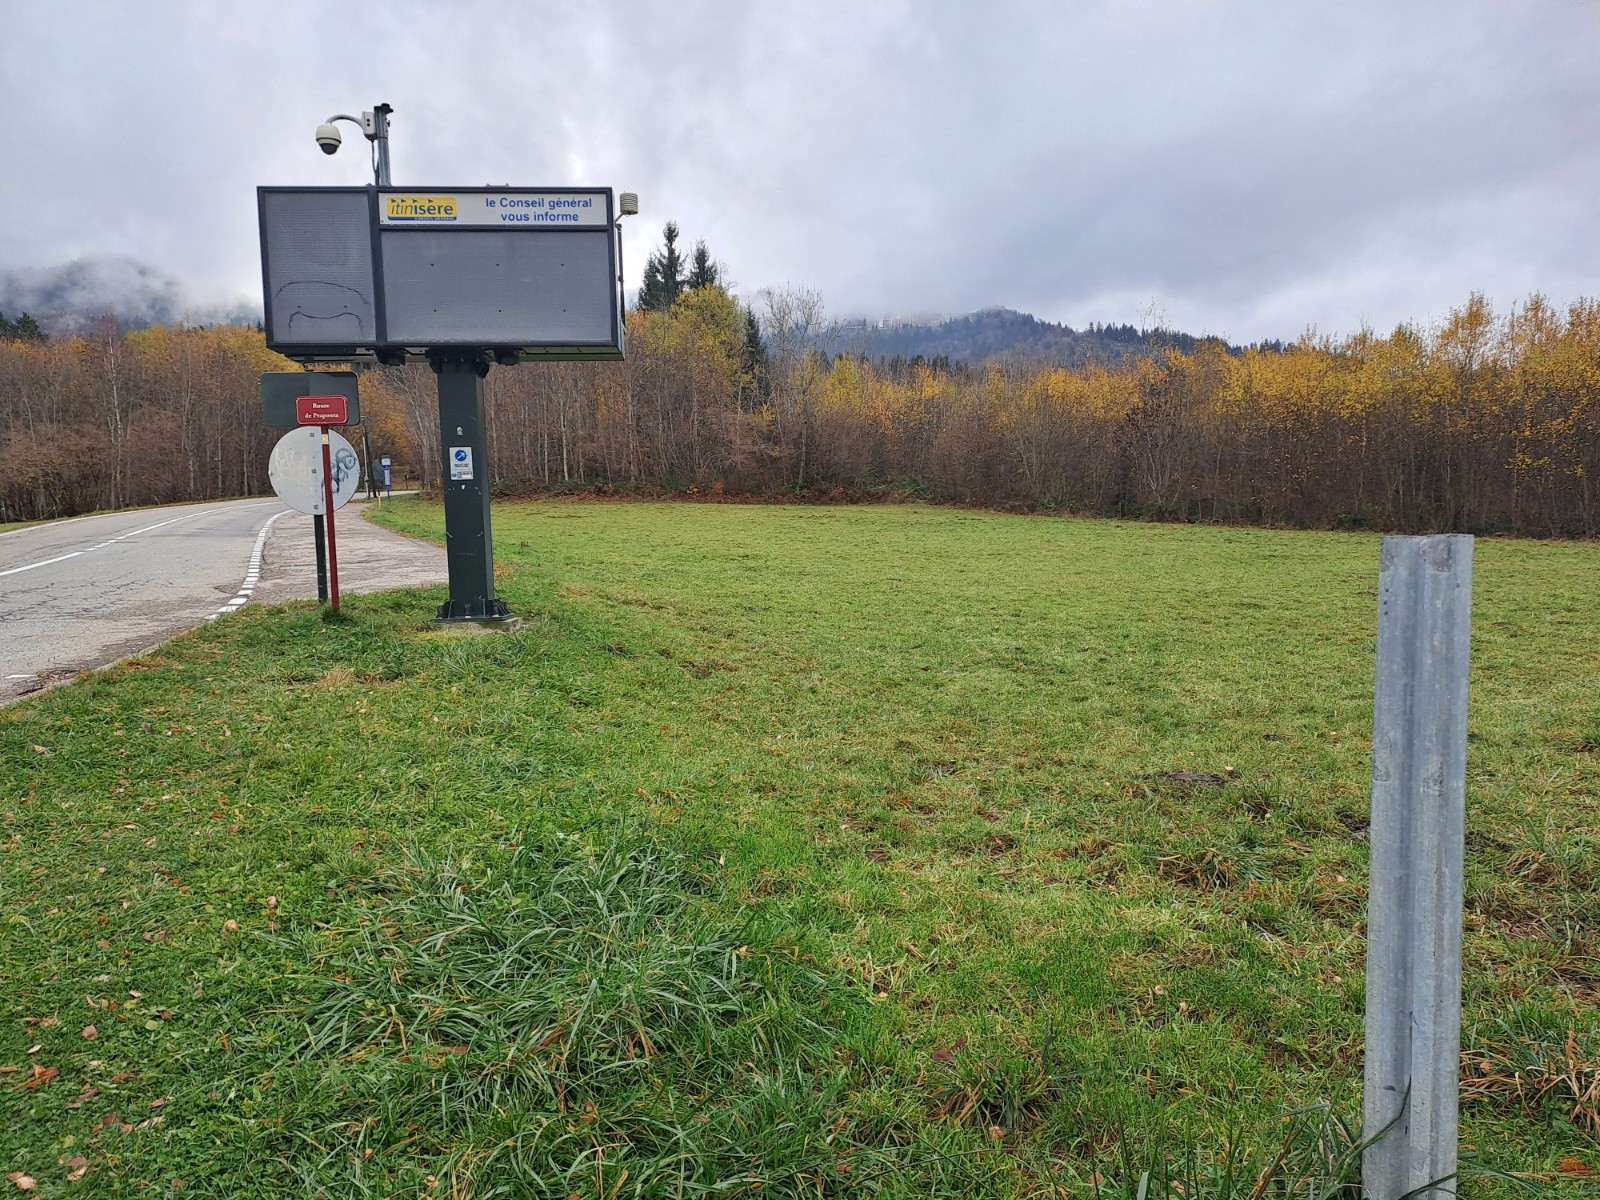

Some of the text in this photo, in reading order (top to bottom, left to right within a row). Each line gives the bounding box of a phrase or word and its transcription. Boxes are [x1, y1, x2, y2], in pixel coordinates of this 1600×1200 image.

[486, 197, 592, 210] le Conseil général
[501, 211, 579, 221] vous informe
